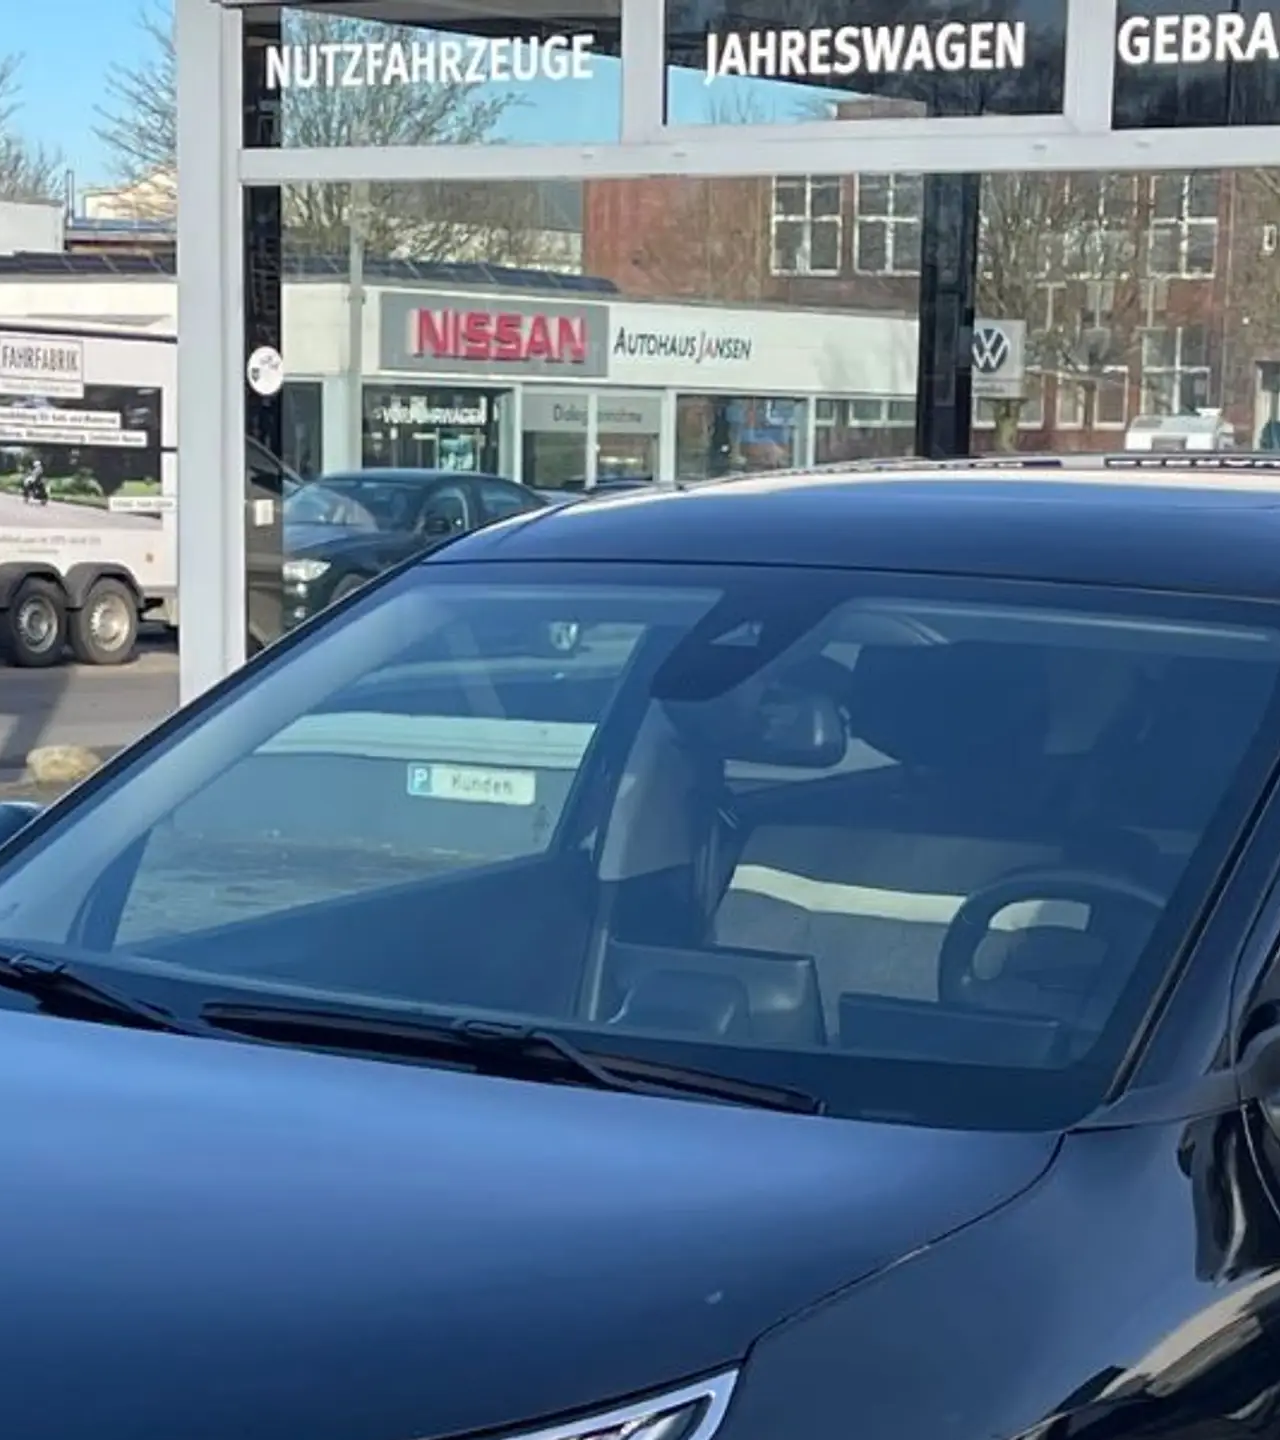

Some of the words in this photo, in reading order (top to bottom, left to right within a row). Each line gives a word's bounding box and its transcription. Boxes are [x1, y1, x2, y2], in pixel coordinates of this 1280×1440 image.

[266, 34, 594, 90] NUTZFAHRZEUGE
[704, 21, 1026, 86] JAHRESWAGEN
[0, 345, 80, 372] FAHRFABRIK
[410, 305, 590, 363] NISSAN
[613, 326, 696, 357] AUTOHAUS
